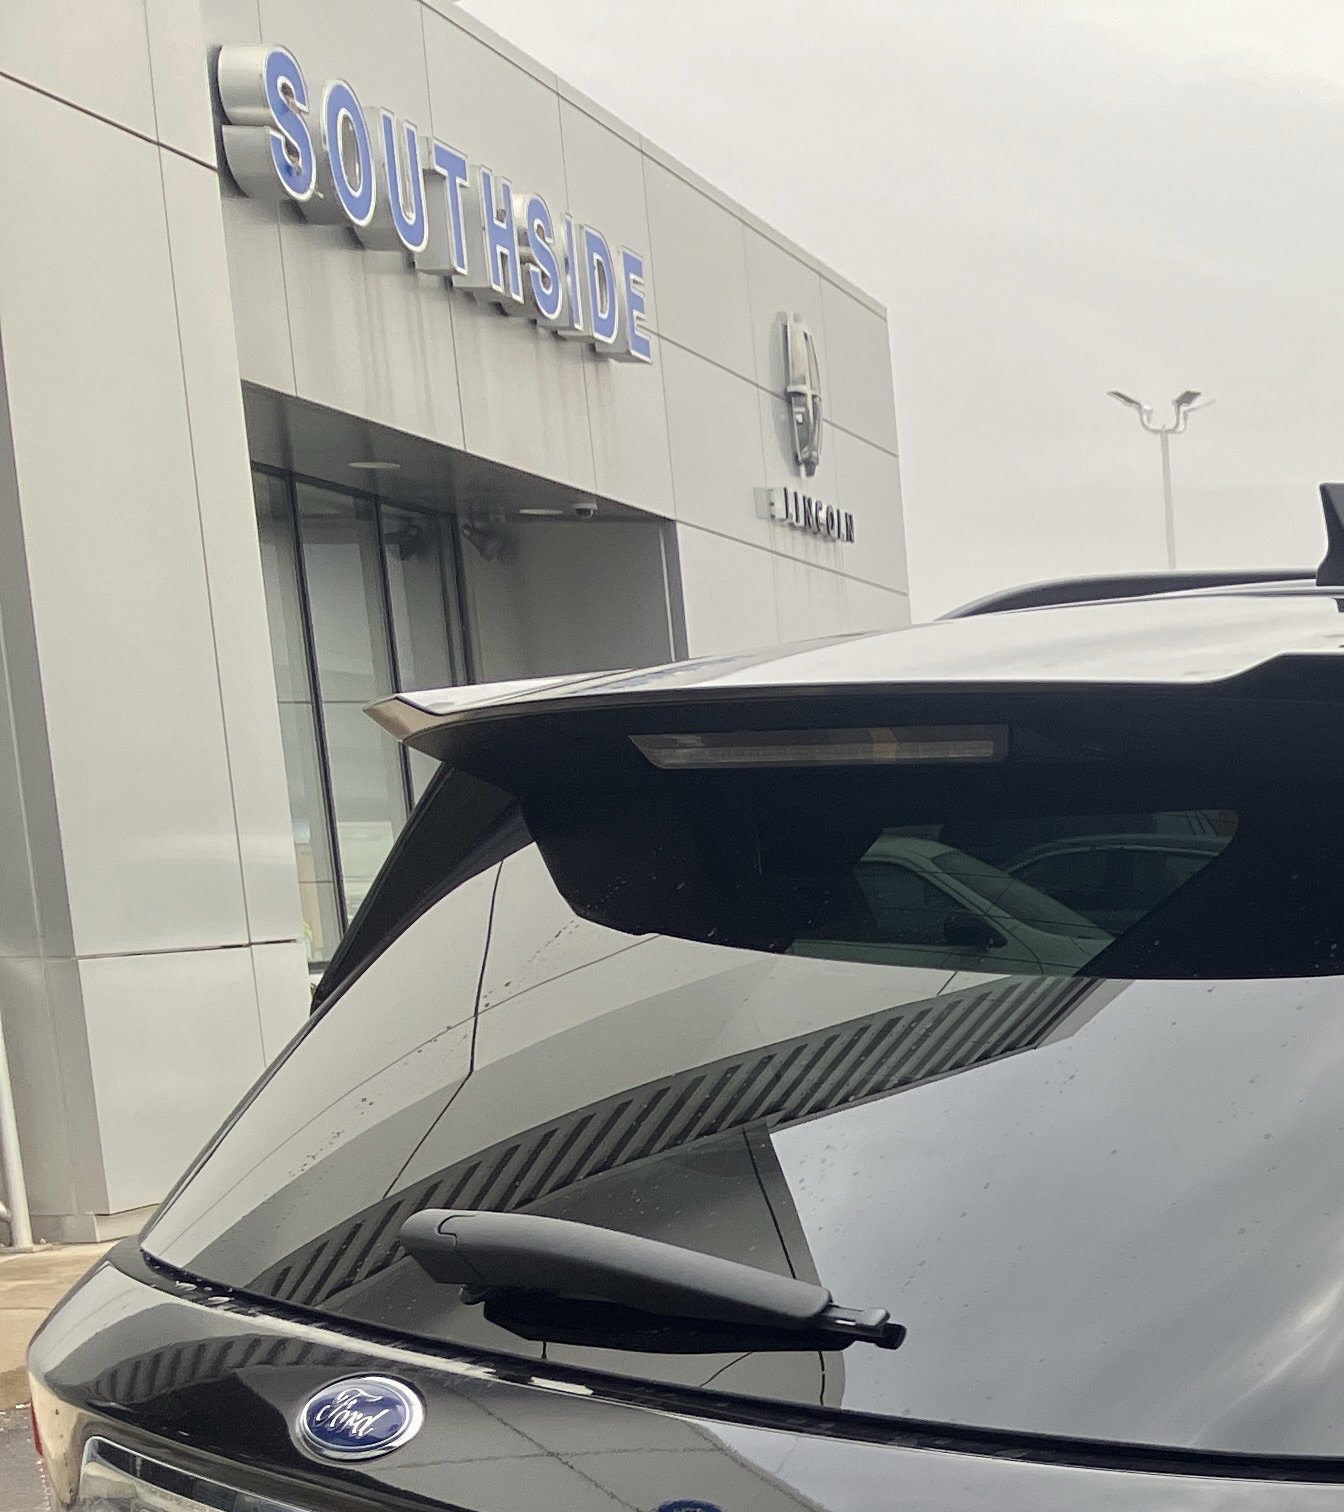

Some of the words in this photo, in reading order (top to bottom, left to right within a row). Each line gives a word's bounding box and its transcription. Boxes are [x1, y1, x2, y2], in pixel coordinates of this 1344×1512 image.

[264, 44, 653, 364] SOUTHSIDE
[781, 485, 856, 543] LINCOLN
[311, 1387, 391, 1440] Ford
